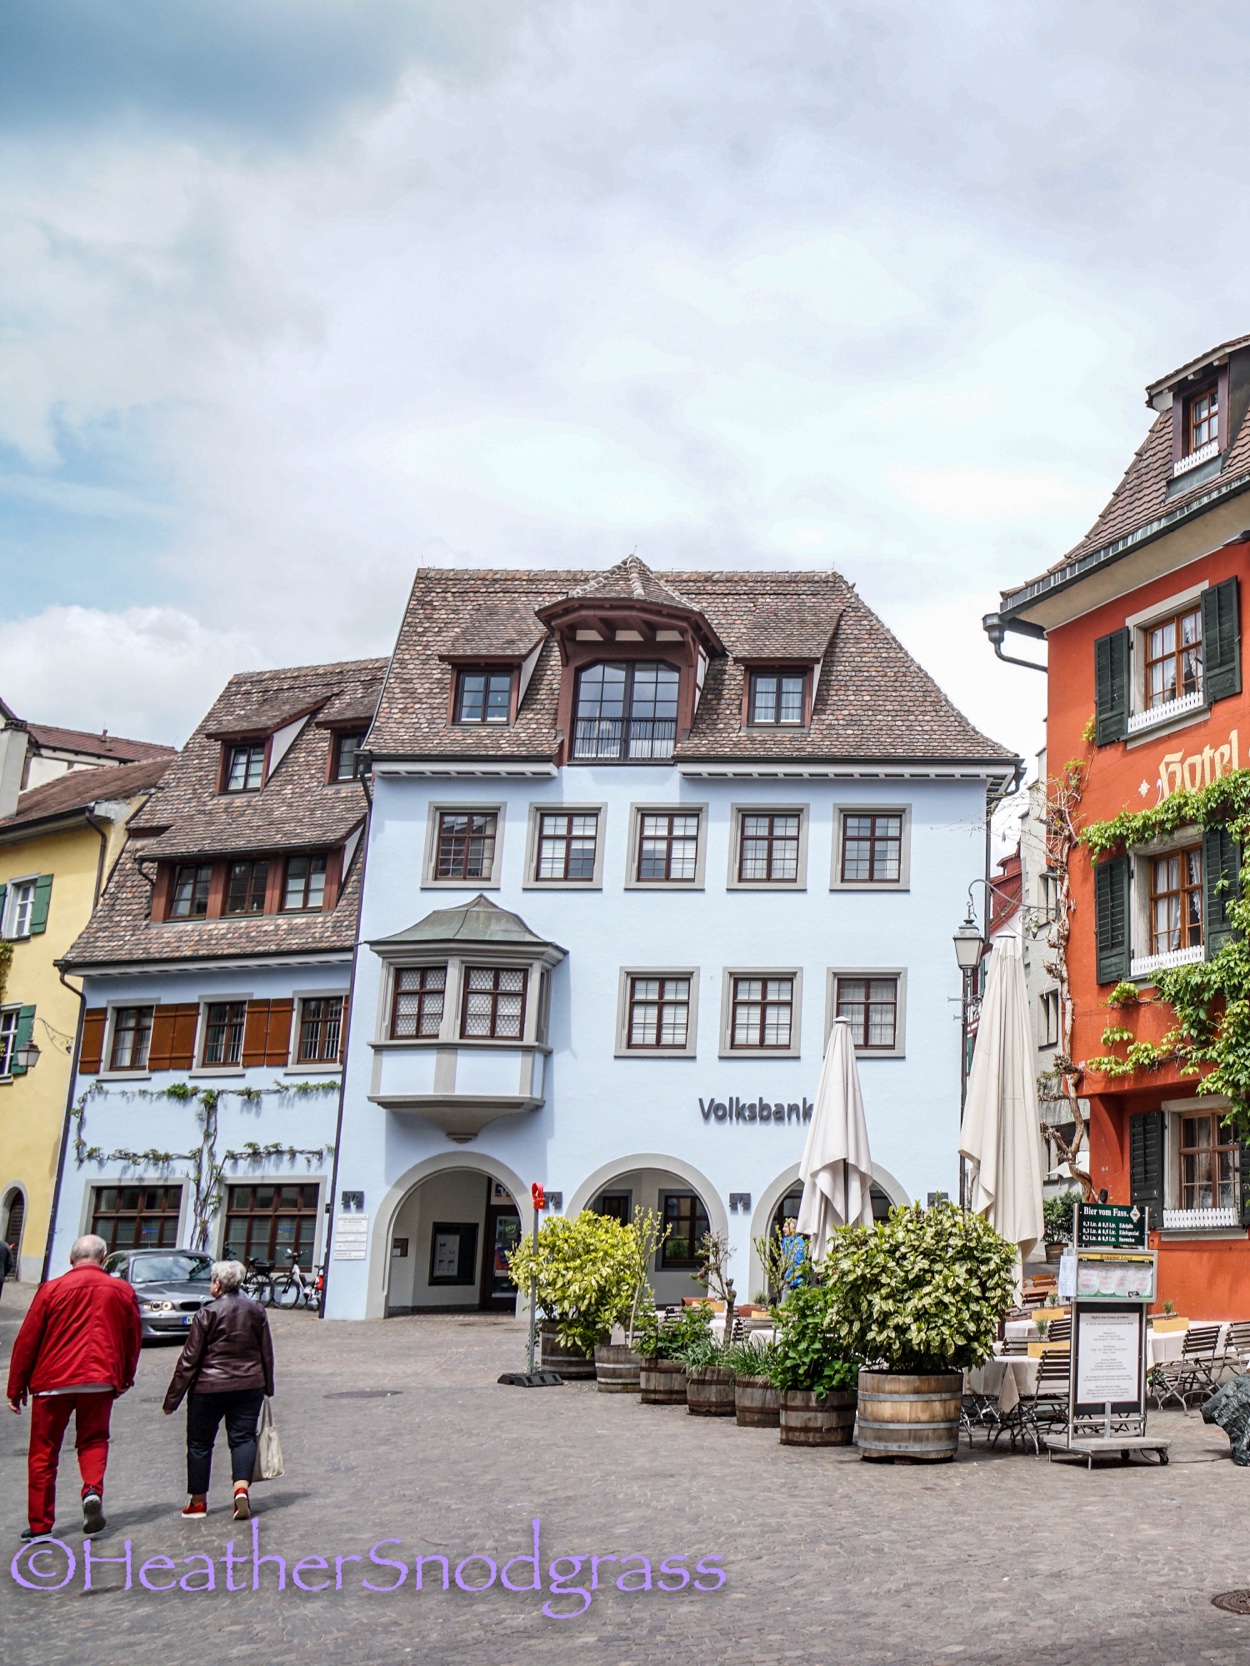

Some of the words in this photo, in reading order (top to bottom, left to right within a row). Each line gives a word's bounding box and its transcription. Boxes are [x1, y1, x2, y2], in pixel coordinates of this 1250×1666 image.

[1156, 729, 1239, 802] Hotel
[697, 1096, 814, 1121] Volksbank
[1084, 1206, 1097, 1215] Bier
[1113, 1208, 1129, 1217] Fass.
